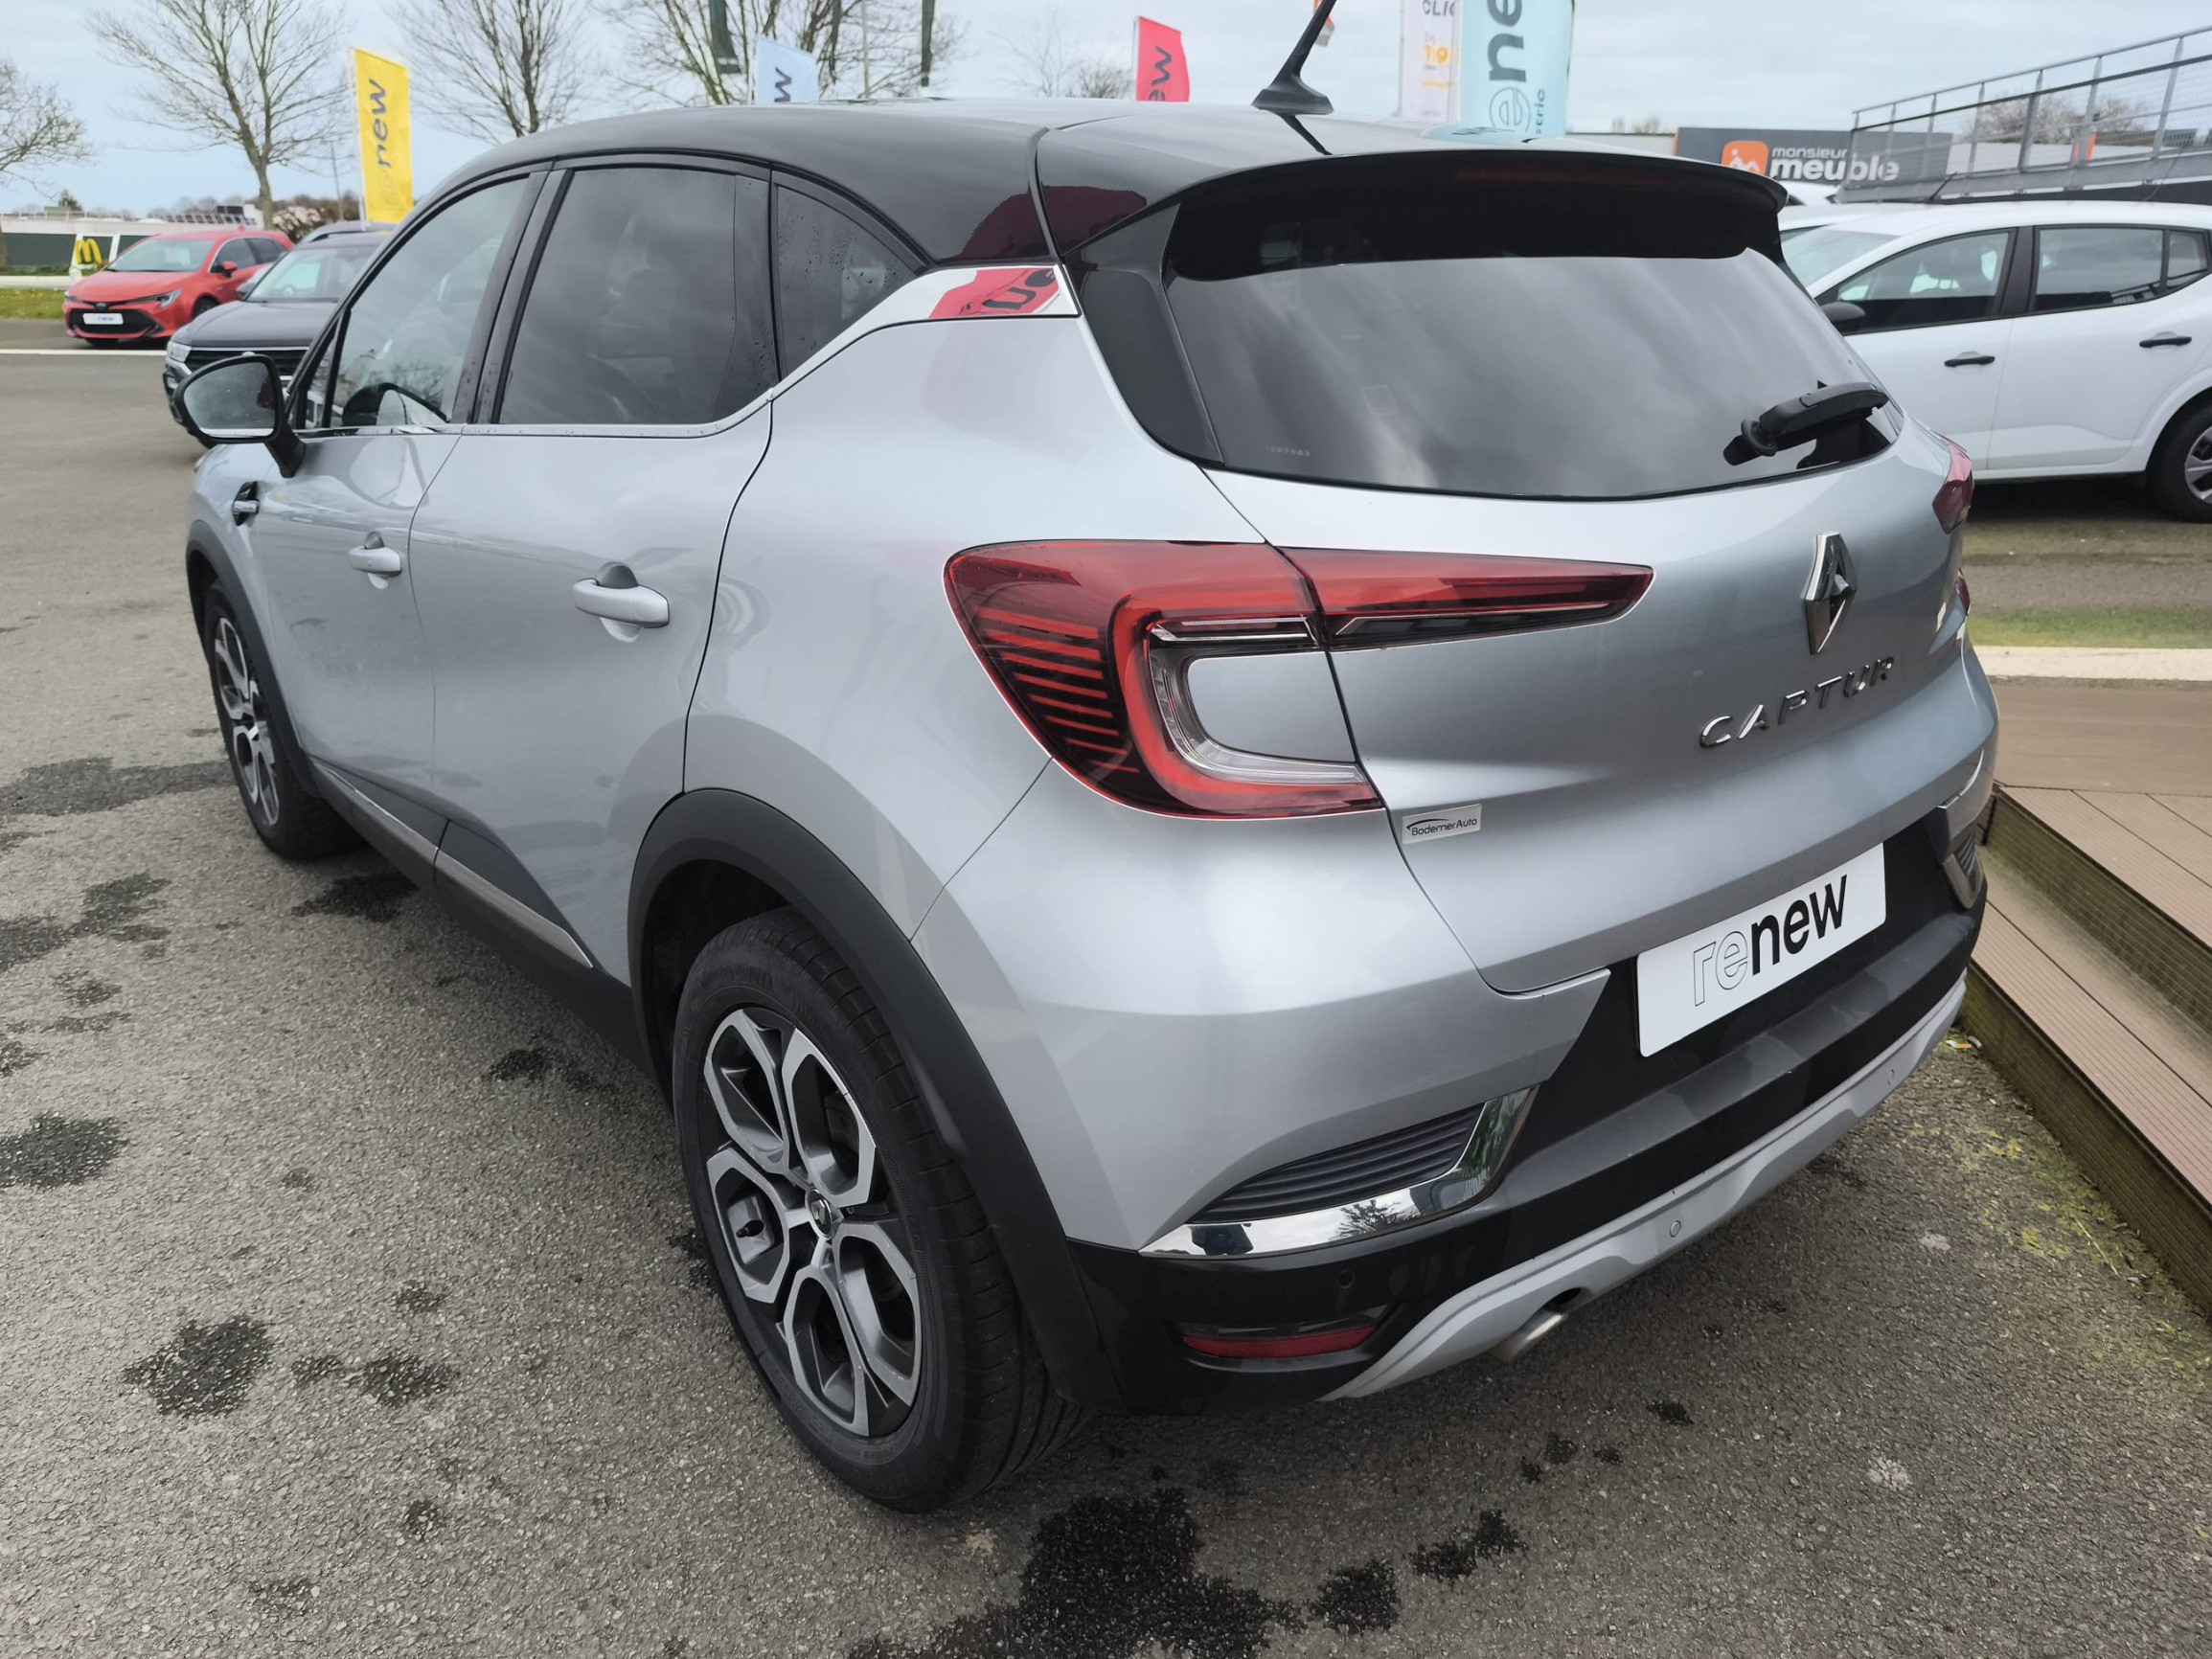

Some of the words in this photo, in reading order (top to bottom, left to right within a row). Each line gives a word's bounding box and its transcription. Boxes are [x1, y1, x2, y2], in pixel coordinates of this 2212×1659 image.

[1769, 153, 1901, 182] meuble
[1772, 147, 1848, 160] monsieur
[1699, 656, 1895, 749] CAPTUR
[1693, 874, 1848, 1008] renew
